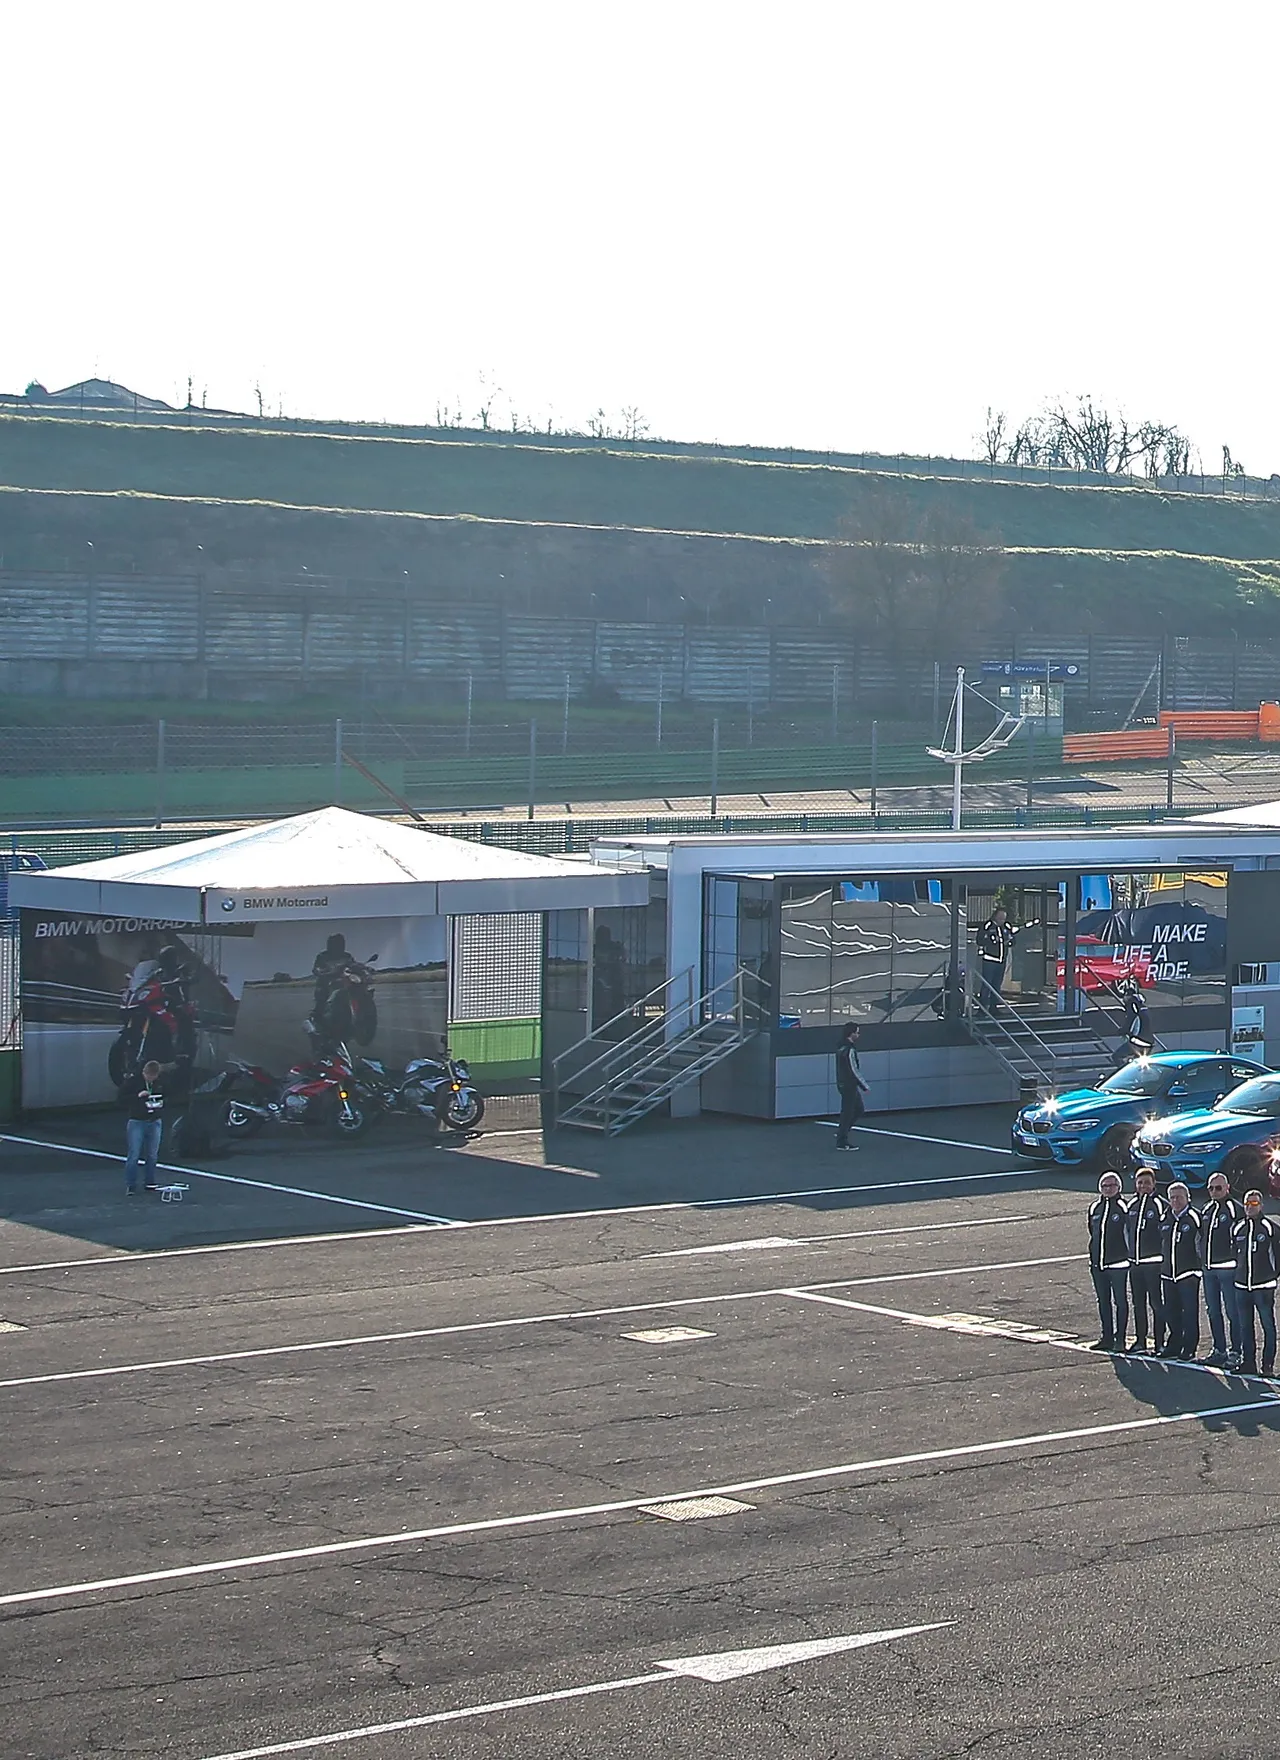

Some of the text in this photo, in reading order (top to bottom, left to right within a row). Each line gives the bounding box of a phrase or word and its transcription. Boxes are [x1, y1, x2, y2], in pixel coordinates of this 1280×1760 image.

[244, 896, 329, 908] BMW Motorrad
[35, 918, 186, 938] BMW MOTORRAD
[1152, 924, 1207, 943] MAKE
[1112, 944, 1168, 963] LIFE A
[1145, 961, 1191, 981] RIDE.
